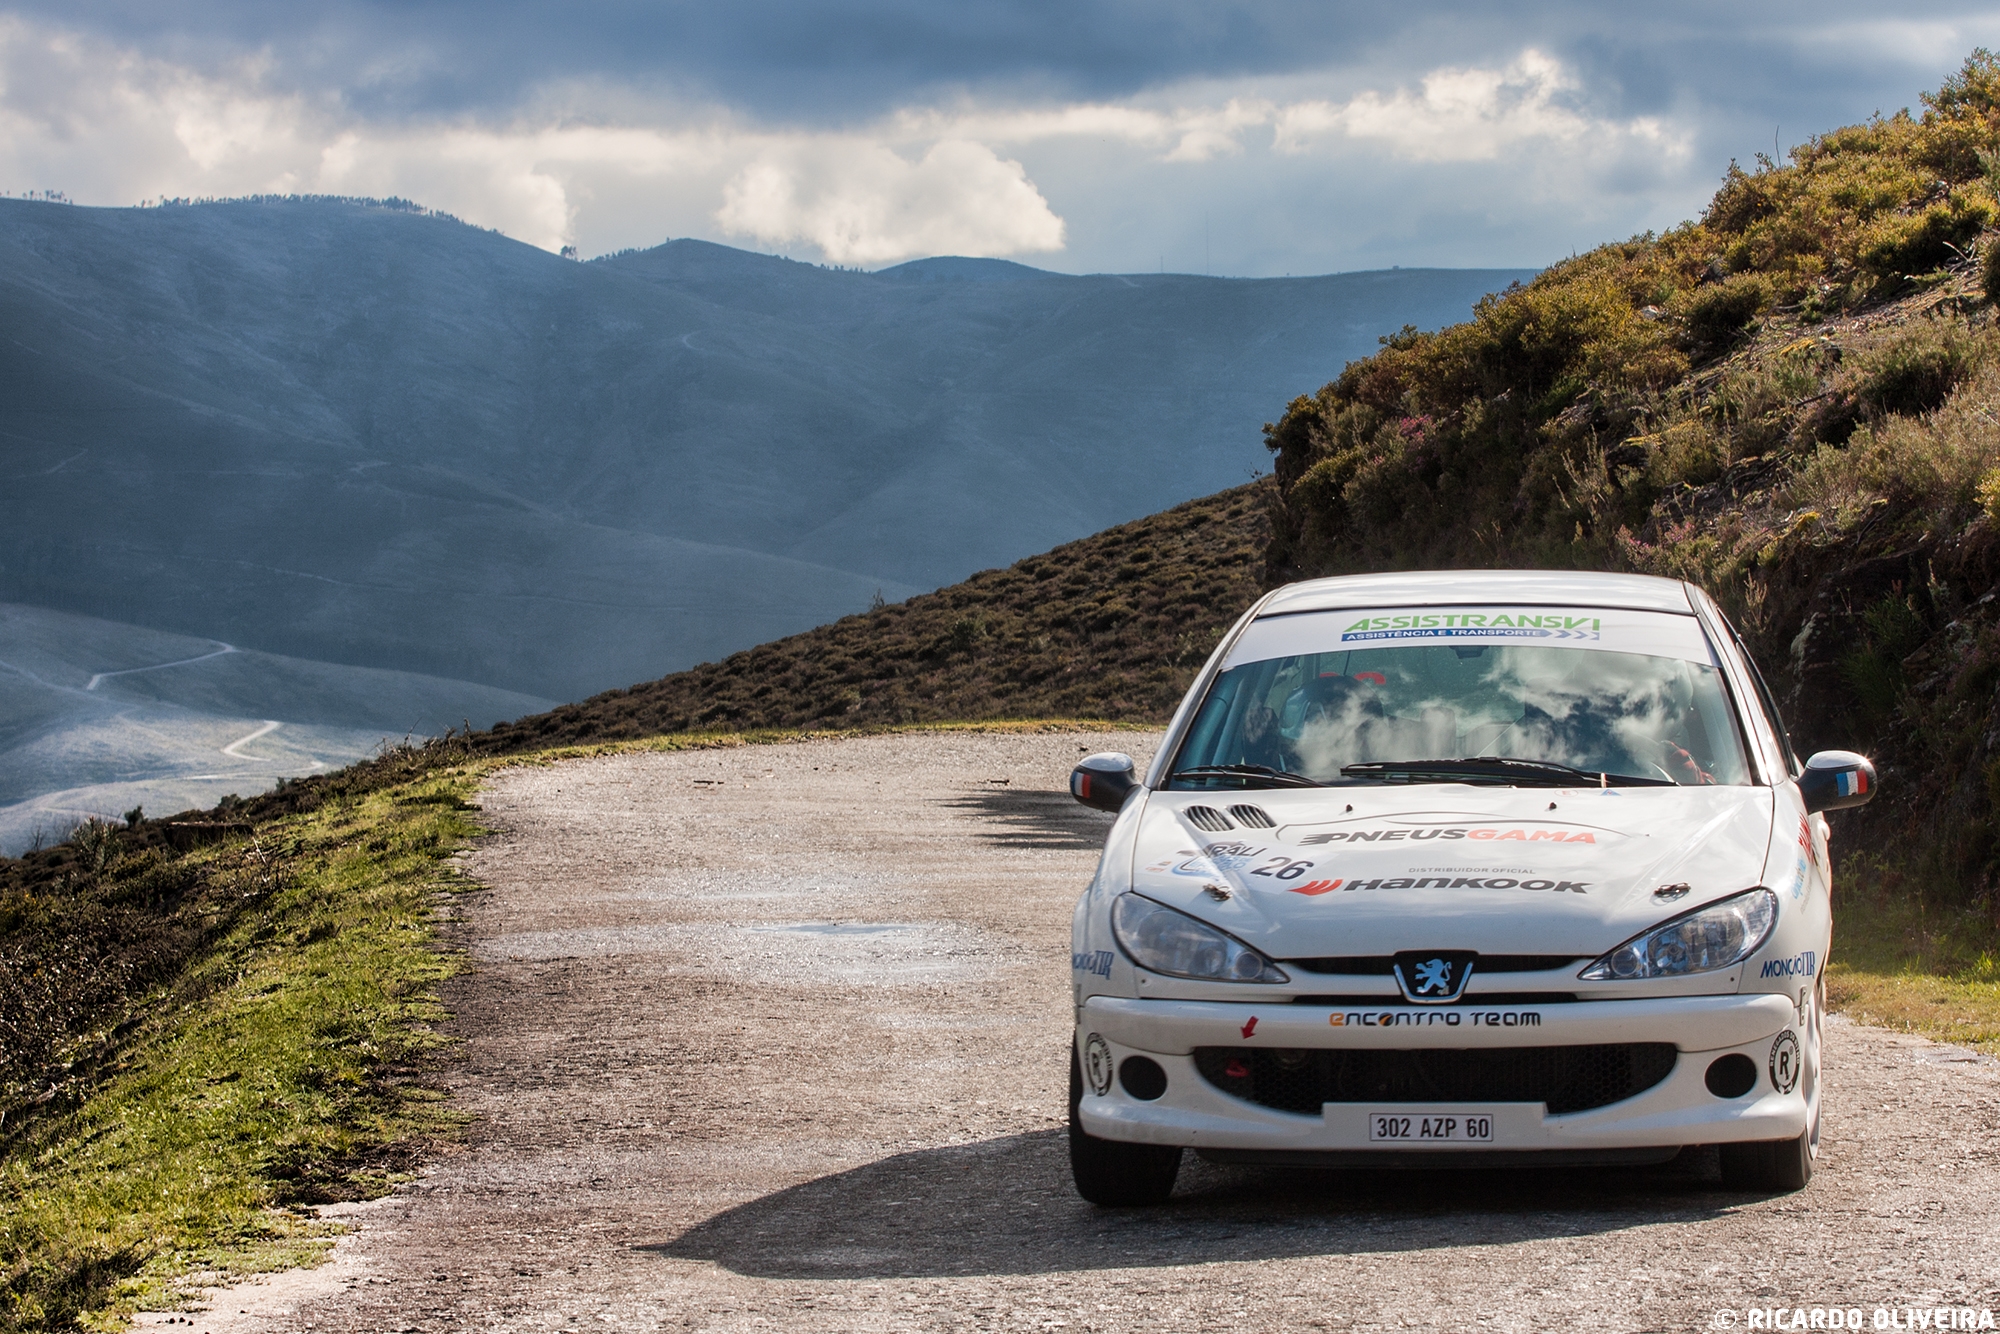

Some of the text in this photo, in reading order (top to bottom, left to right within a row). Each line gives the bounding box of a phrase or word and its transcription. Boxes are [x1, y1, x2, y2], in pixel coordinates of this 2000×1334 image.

[1450, 629, 1539, 637] TRANSPORTE
[1250, 856, 1315, 880] 26
[1377, 1117, 1490, 1138] 302 AZP 60
